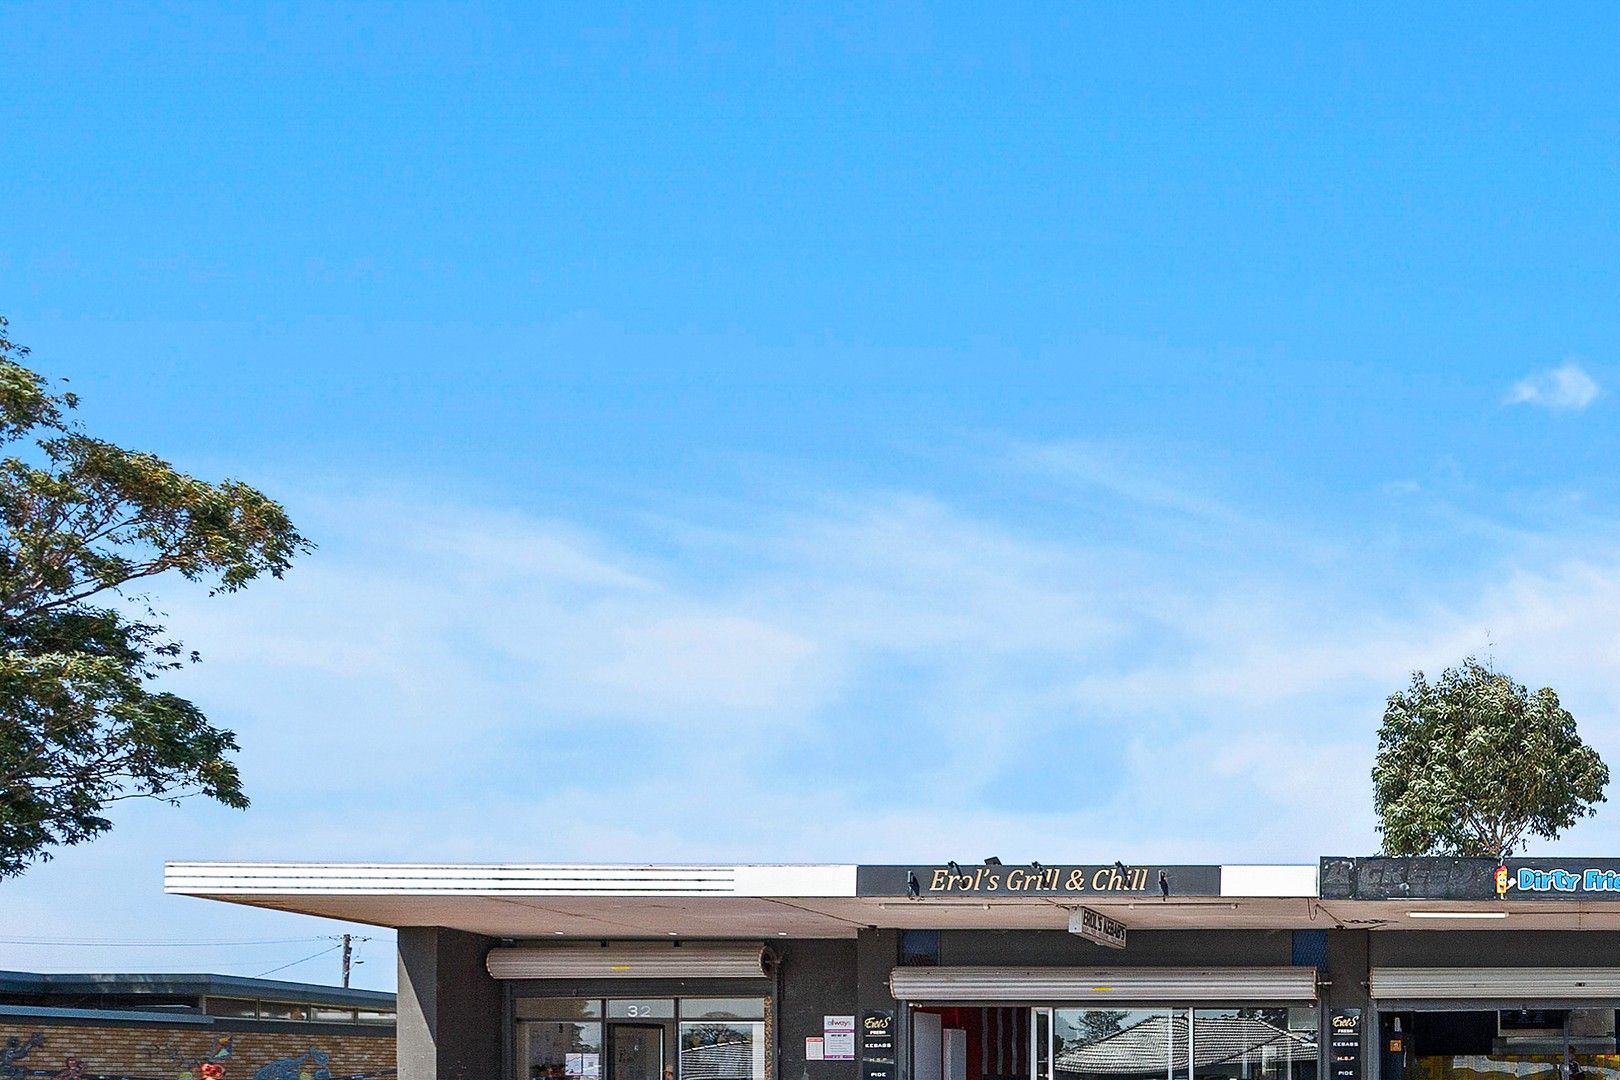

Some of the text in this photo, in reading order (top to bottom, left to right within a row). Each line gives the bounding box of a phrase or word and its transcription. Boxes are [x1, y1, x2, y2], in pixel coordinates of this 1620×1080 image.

[930, 868, 1148, 891] Erol's Grill & Chill
[1518, 868, 1581, 891] Dirty
[627, 1005, 651, 1018] 32
